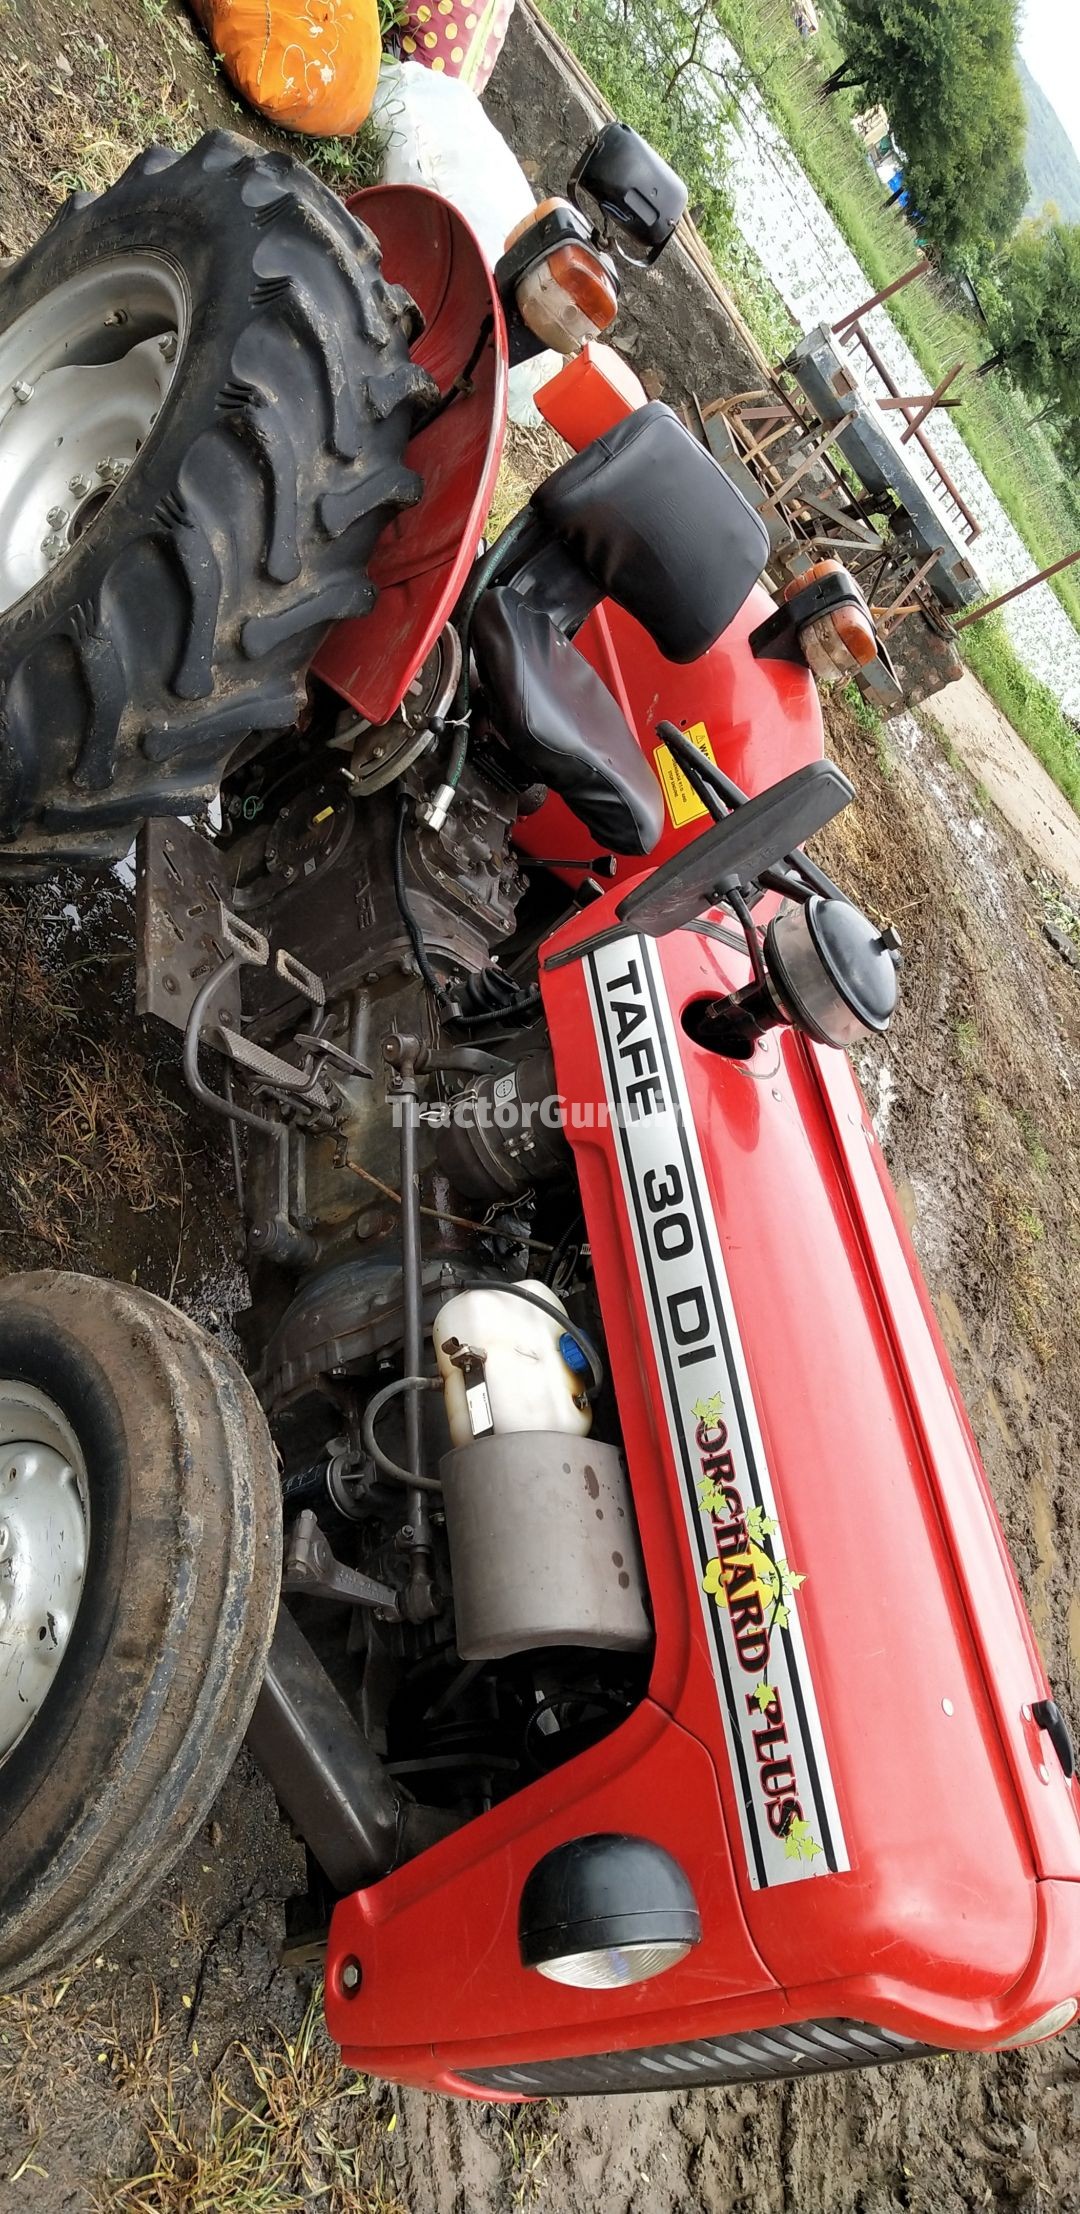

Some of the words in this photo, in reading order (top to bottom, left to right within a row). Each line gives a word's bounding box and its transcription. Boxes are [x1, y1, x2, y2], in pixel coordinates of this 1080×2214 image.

[605, 959, 667, 1123] TAFE
[643, 1163, 694, 1261] 30
[666, 1286, 717, 1369] DI
[695, 1417, 772, 1674] ORCHARD
[744, 1686, 805, 1839] PLUS
